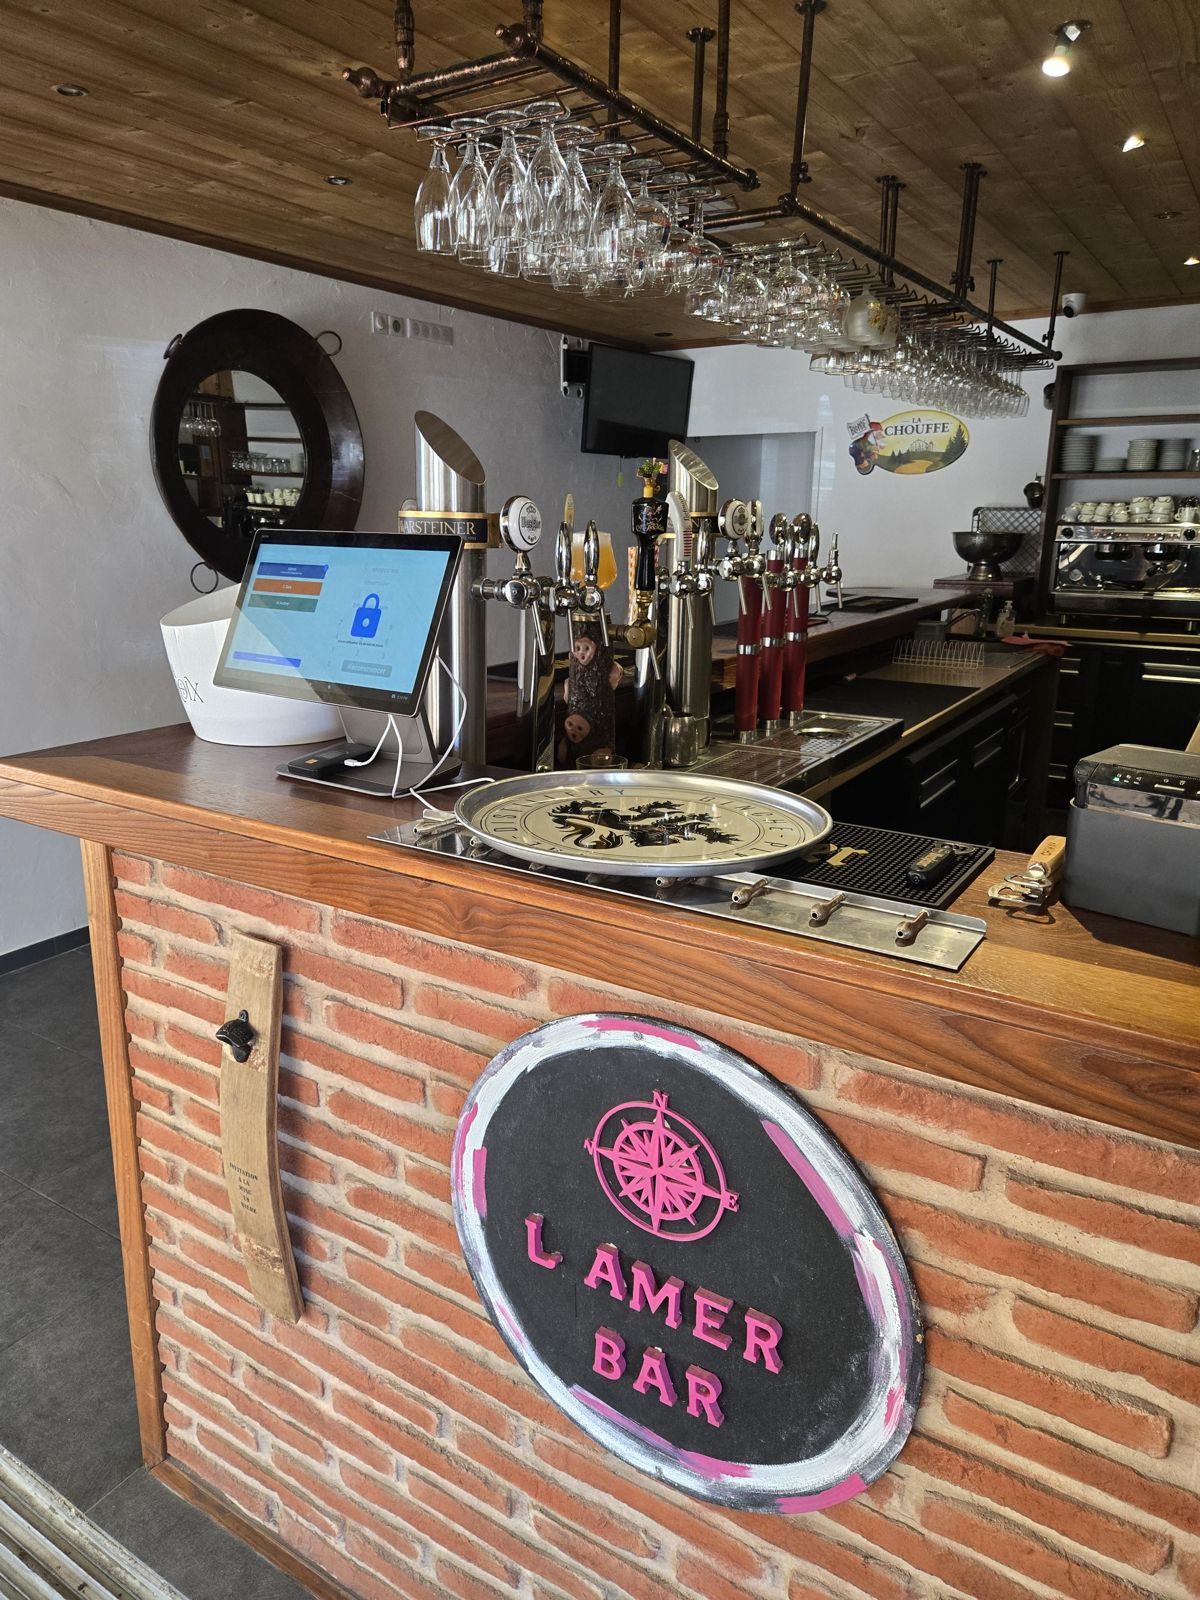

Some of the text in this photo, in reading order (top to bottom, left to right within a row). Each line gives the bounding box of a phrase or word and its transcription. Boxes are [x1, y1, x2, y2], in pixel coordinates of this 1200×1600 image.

[884, 422, 950, 437] CHOUFFE
[583, 1242, 784, 1375] AMER
[592, 1325, 725, 1428] BAR
